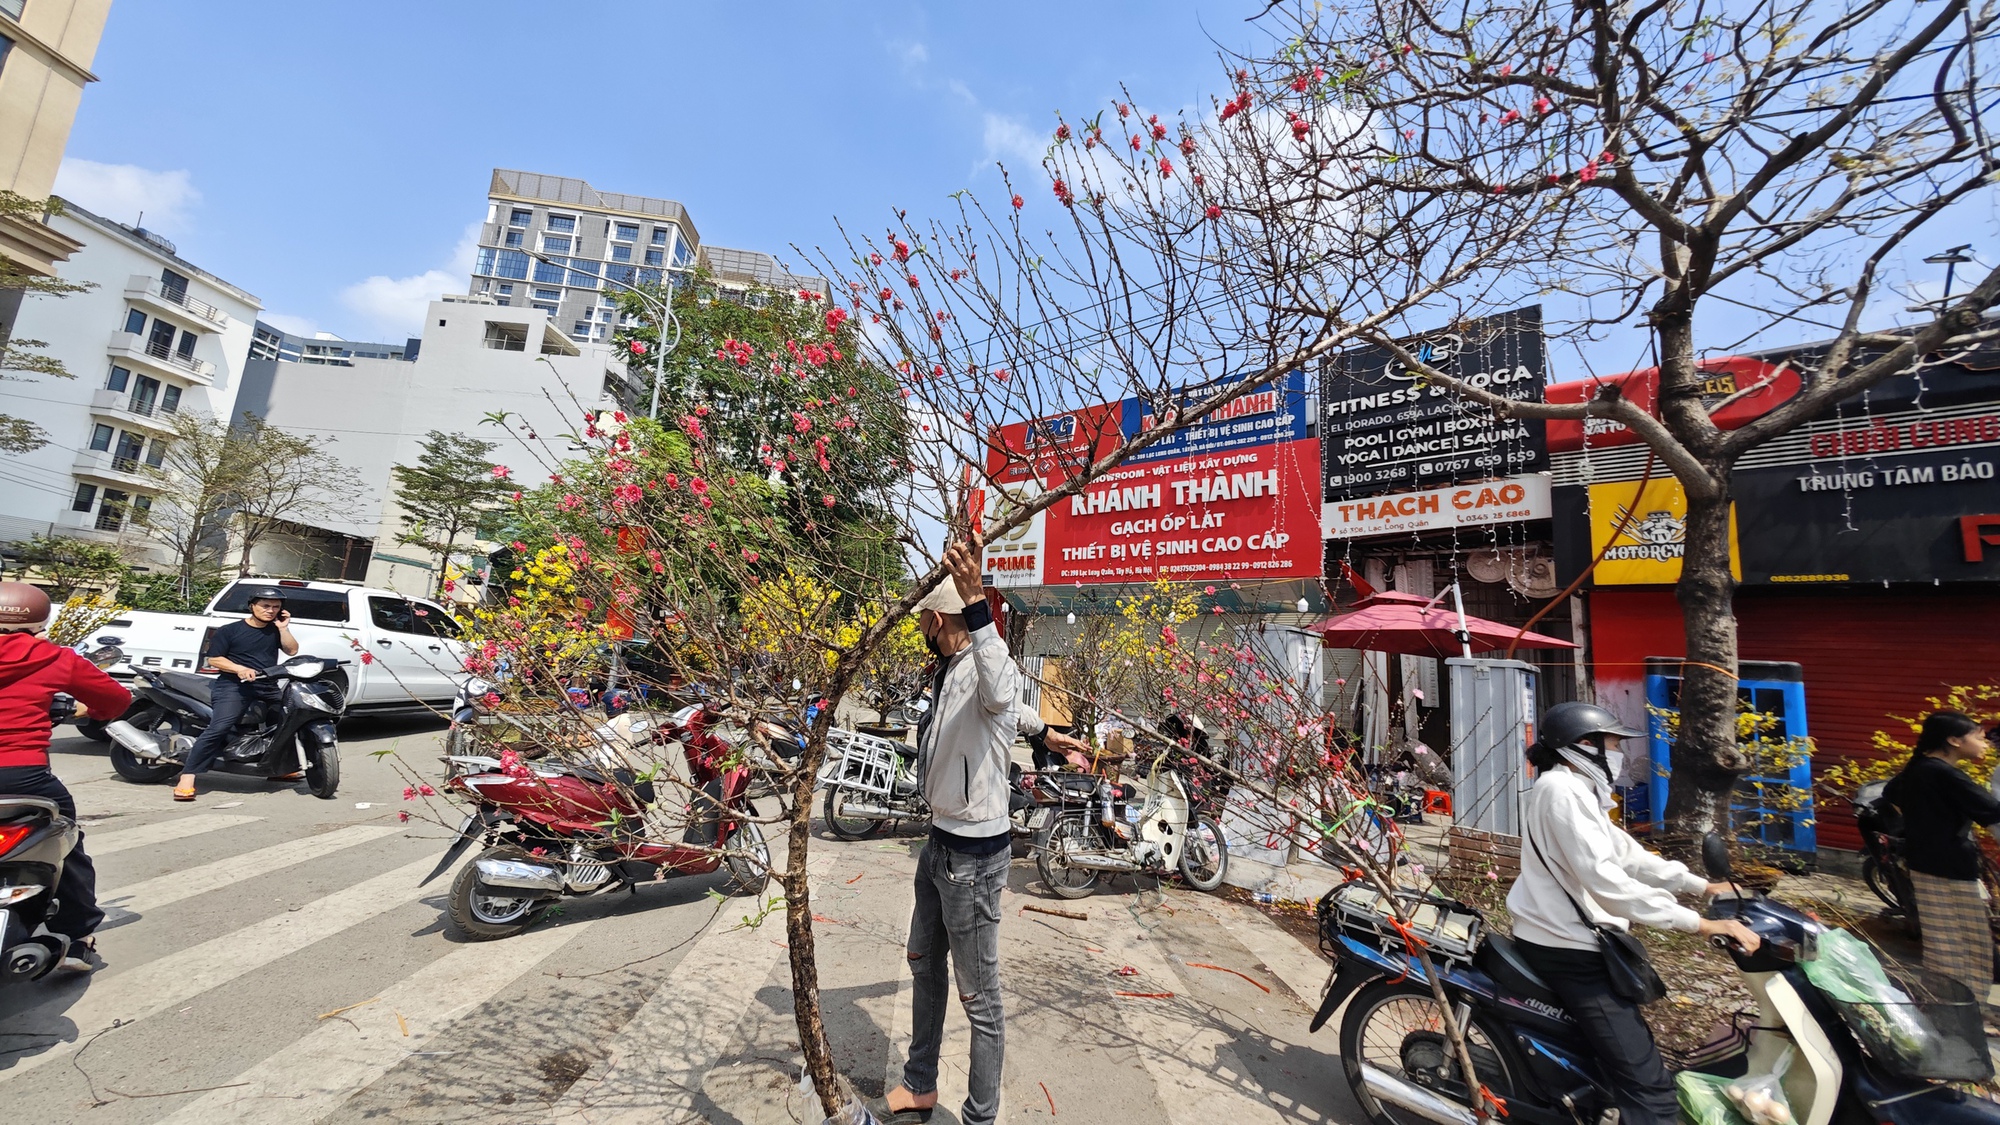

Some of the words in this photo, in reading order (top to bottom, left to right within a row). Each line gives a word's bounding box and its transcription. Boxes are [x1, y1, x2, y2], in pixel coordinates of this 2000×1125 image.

[1328, 386, 1421, 416] FITNESS
[1429, 385, 1446, 397] &
[1220, 423, 1232, 437] VỆ
[1232, 420, 1254, 434] SINH
[1255, 417, 1274, 430] CAO
[1331, 424, 1344, 433] EL
[1345, 415, 1395, 430] DORADO,
[1396, 409, 1425, 421] 659A
[1427, 404, 1451, 416] LẠC
[1337, 450, 1381, 465] YOGA
[1392, 437, 1452, 457] DANCE
[1462, 427, 1530, 446] SAUNA
[1344, 433, 1387, 449] POOL
[1396, 426, 1433, 441] GYM
[1152, 465, 1171, 476] VẬT
[1174, 460, 1197, 474] LIỆU
[1198, 456, 1220, 470] XÂY
[1223, 453, 1258, 467] DỰNG
[1343, 472, 1373, 485] 1900
[1375, 467, 1407, 483] 3268
[1434, 459, 1470, 473] 0767
[1474, 454, 1502, 467] 659
[1507, 450, 1536, 463] 659
[1797, 470, 1874, 492] TRUNG
[1880, 464, 1935, 486] TÂM
[1941, 456, 1994, 481] BẢO
[1072, 483, 1161, 516] KHÁNH
[1171, 469, 1278, 506] THÀNH
[1338, 494, 1439, 523] THẠCH
[1451, 484, 1525, 511] CAO
[1111, 519, 1156, 538] GẠCH
[1161, 513, 1185, 531] ỐP
[1191, 511, 1225, 528] LÁT
[1384, 522, 1405, 531] Long
[1466, 512, 1488, 522] 0345
[1493, 511, 1503, 519] 25
[1062, 541, 1106, 560] THIẾT
[1111, 544, 1126, 561] BỊ
[1131, 540, 1151, 560] VỆ
[1156, 540, 1197, 555] SINH
[1202, 536, 1242, 552] CAO
[1247, 527, 1290, 550] CẤP
[1653, 533, 1669, 541] TV
[987, 555, 1036, 572] PRIME
[1524, 997, 1564, 1018] Angel
